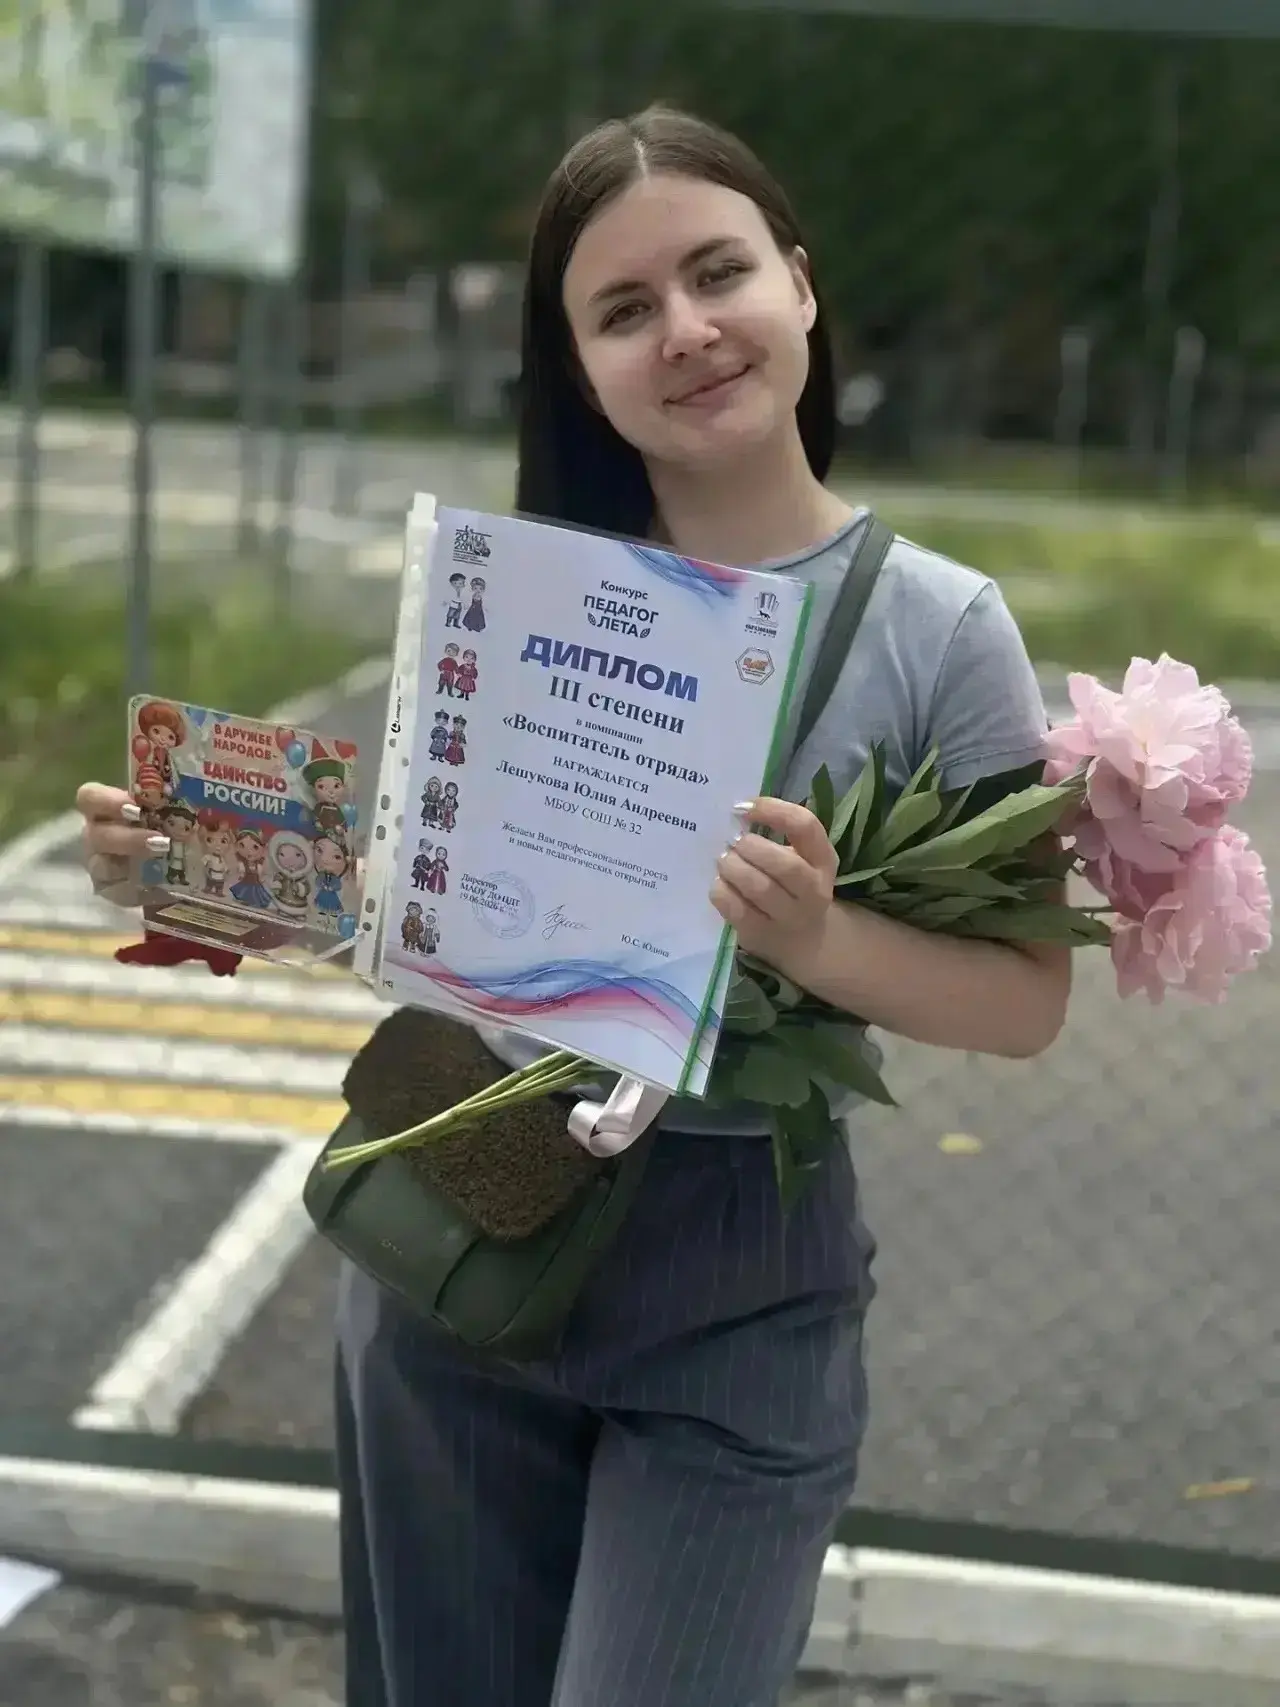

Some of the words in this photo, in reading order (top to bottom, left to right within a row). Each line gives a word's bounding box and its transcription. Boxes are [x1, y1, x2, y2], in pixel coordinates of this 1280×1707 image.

[600, 580, 649, 600] Конкурс
[584, 594, 659, 624] ПЕДАГОГ
[597, 616, 639, 638] ЛЕТА
[520, 633, 699, 702] ДИПЛОМ
[548, 675, 583, 704] III
[587, 692, 685, 734] степени
[214, 723, 221, 735] В
[575, 718, 582, 726] в
[584, 720, 644, 745] номинации
[502, 713, 630, 761] «Воспитатель
[635, 753, 710, 786] отряда»
[203, 760, 288, 793] ЕДИНСТВО
[553, 756, 651, 794] НАГРАЖДАЕТСЯ
[203, 781, 287, 816] РОССИИ!
[496, 759, 570, 791] Лешукова
[573, 781, 617, 806] Юлия
[620, 797, 698, 832] Андреевна
[544, 795, 580, 814] МБОУ
[582, 806, 613, 826] СОШ
[613, 819, 627, 831] №
[628, 822, 643, 835] 32
[502, 820, 535, 839] Желаем
[537, 831, 556, 845] Вам
[643, 867, 669, 882] роста
[509, 836, 515, 844] и
[516, 838, 544, 853] новых
[545, 848, 613, 875] педагогических
[461, 873, 498, 891] Директор
